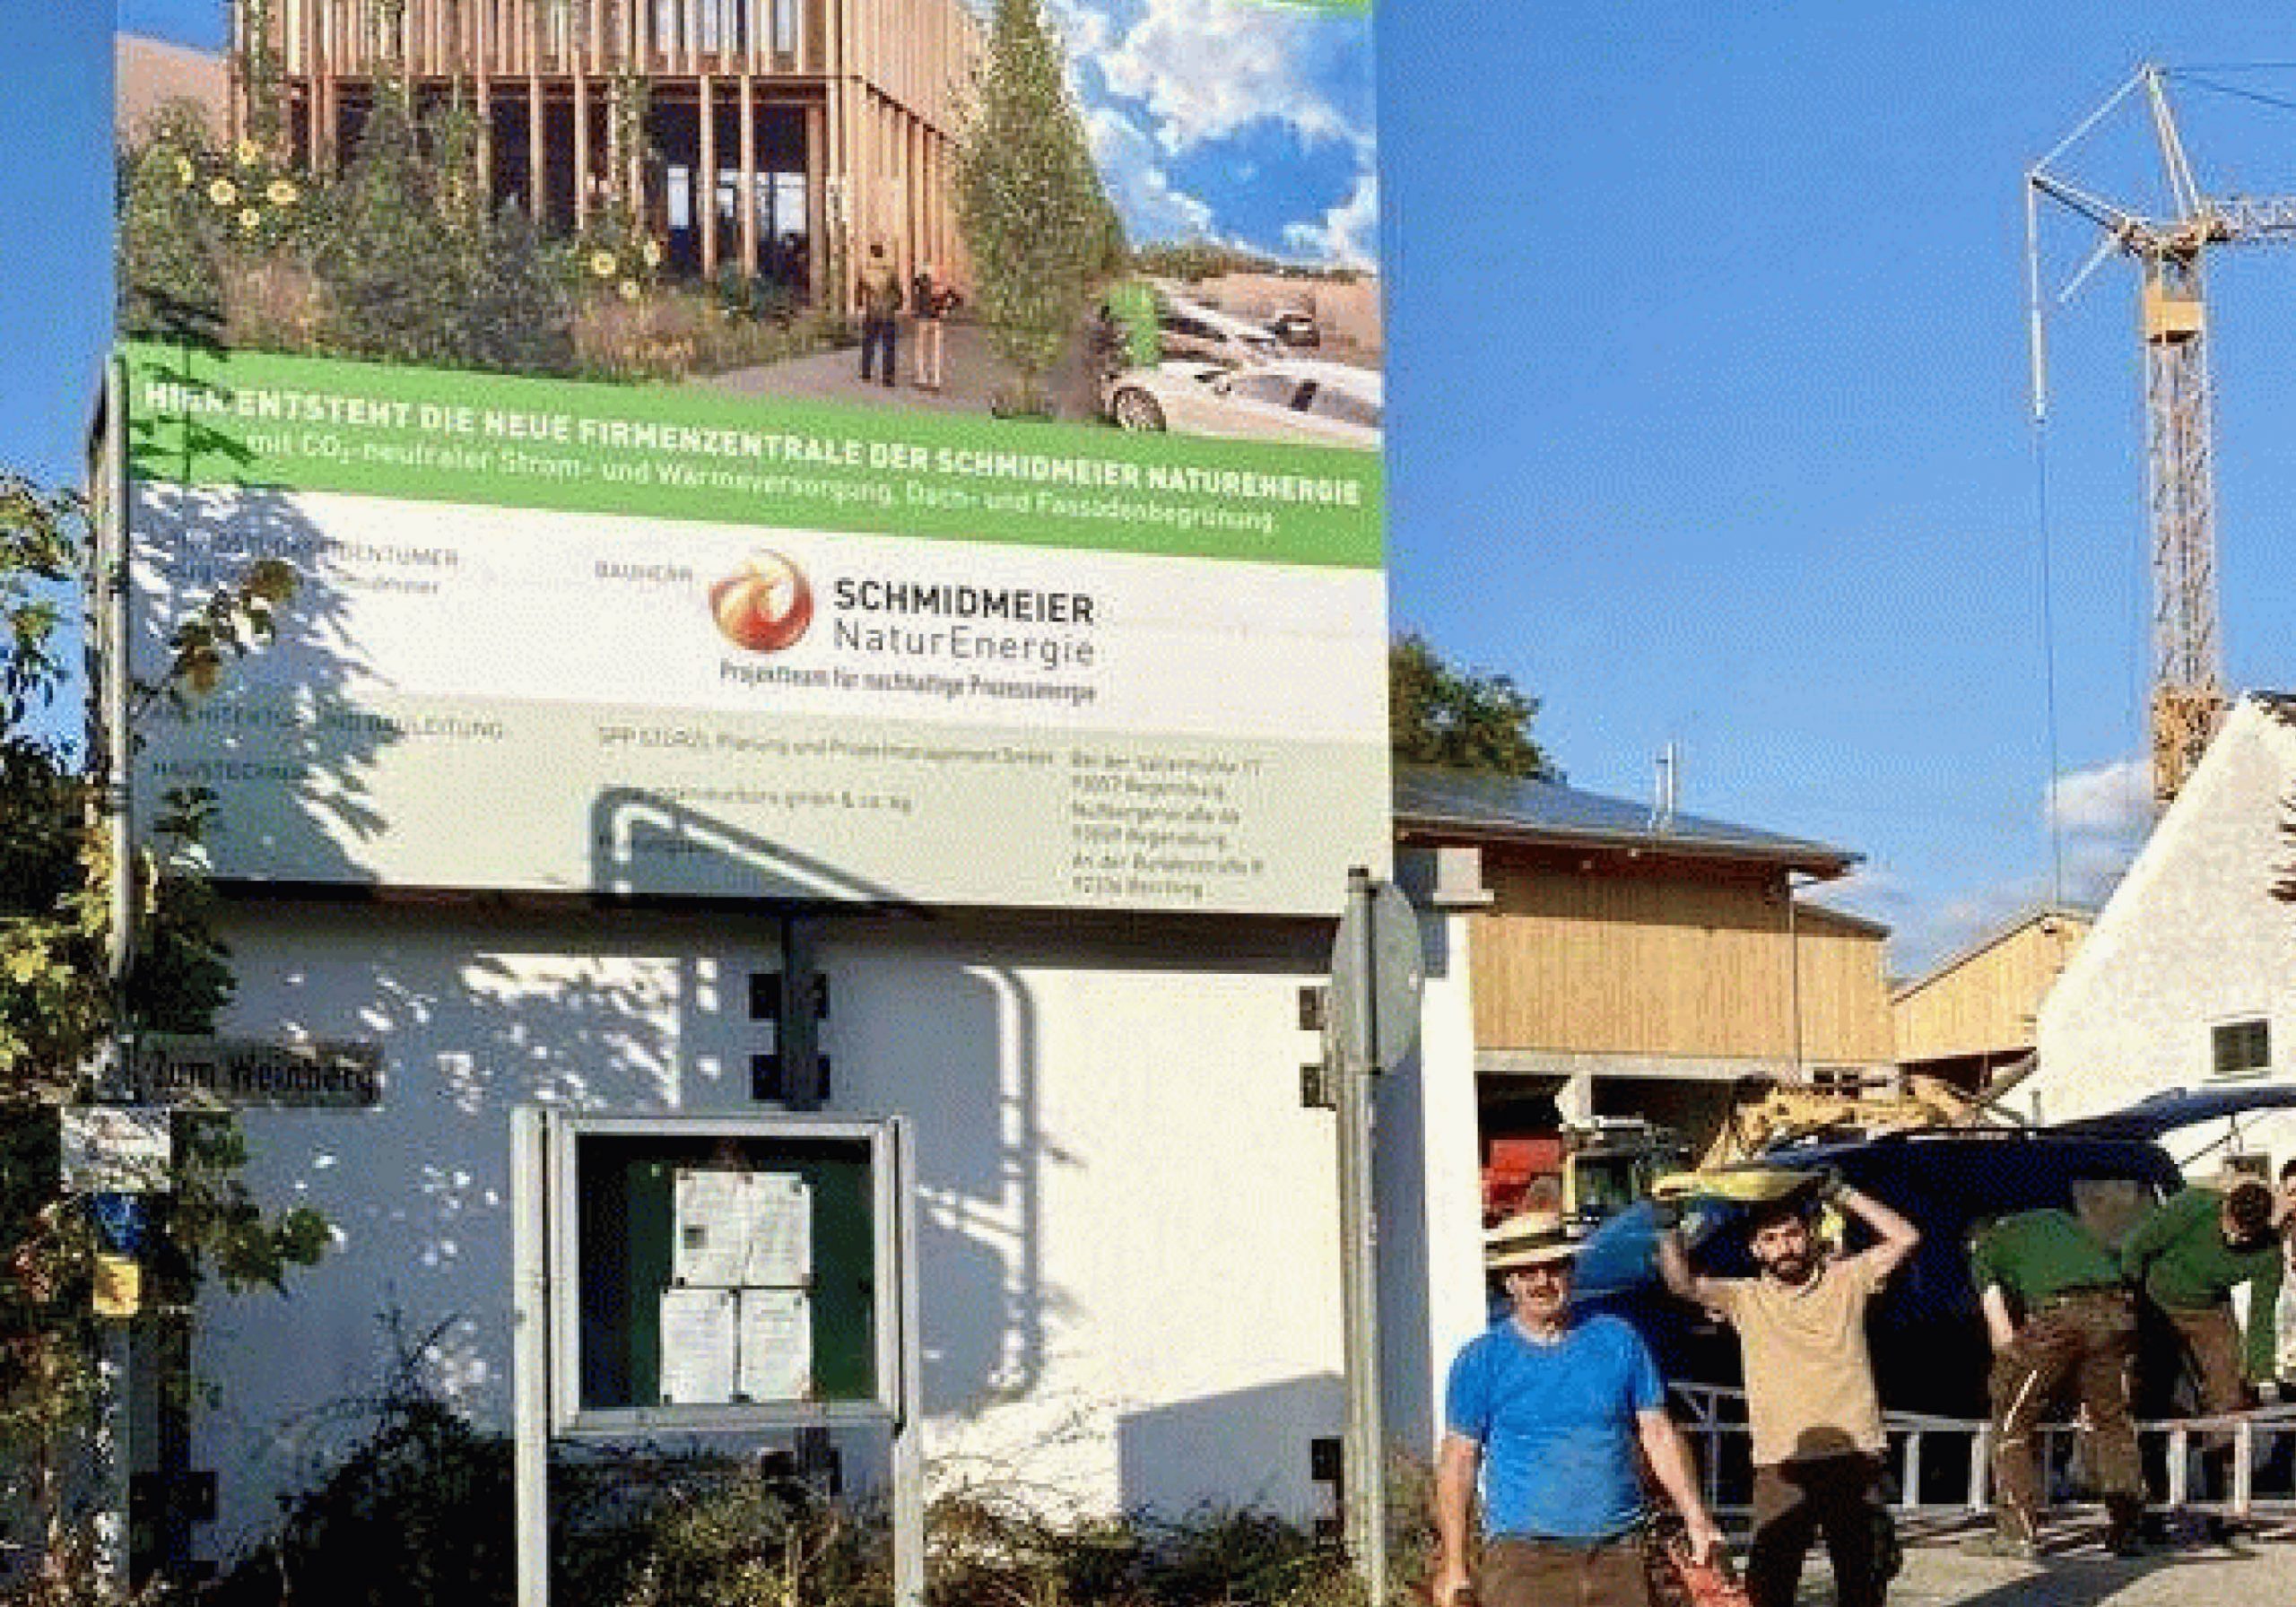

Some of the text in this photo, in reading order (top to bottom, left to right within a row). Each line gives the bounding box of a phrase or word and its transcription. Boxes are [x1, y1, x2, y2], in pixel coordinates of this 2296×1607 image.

[237, 389, 411, 429] ENTSTEHT
[420, 405, 475, 434] DIE
[483, 410, 571, 444] NEUE
[578, 418, 863, 465] FIRMENZENTRALE
[869, 441, 928, 472] DER
[935, 447, 1140, 489] SCHMIDMEIER
[1148, 464, 1362, 505] NATURENERGIE
[602, 457, 648, 482] und
[832, 577, 1095, 625] SCHMIDMEIER
[832, 617, 1095, 672] NaturEnergie
